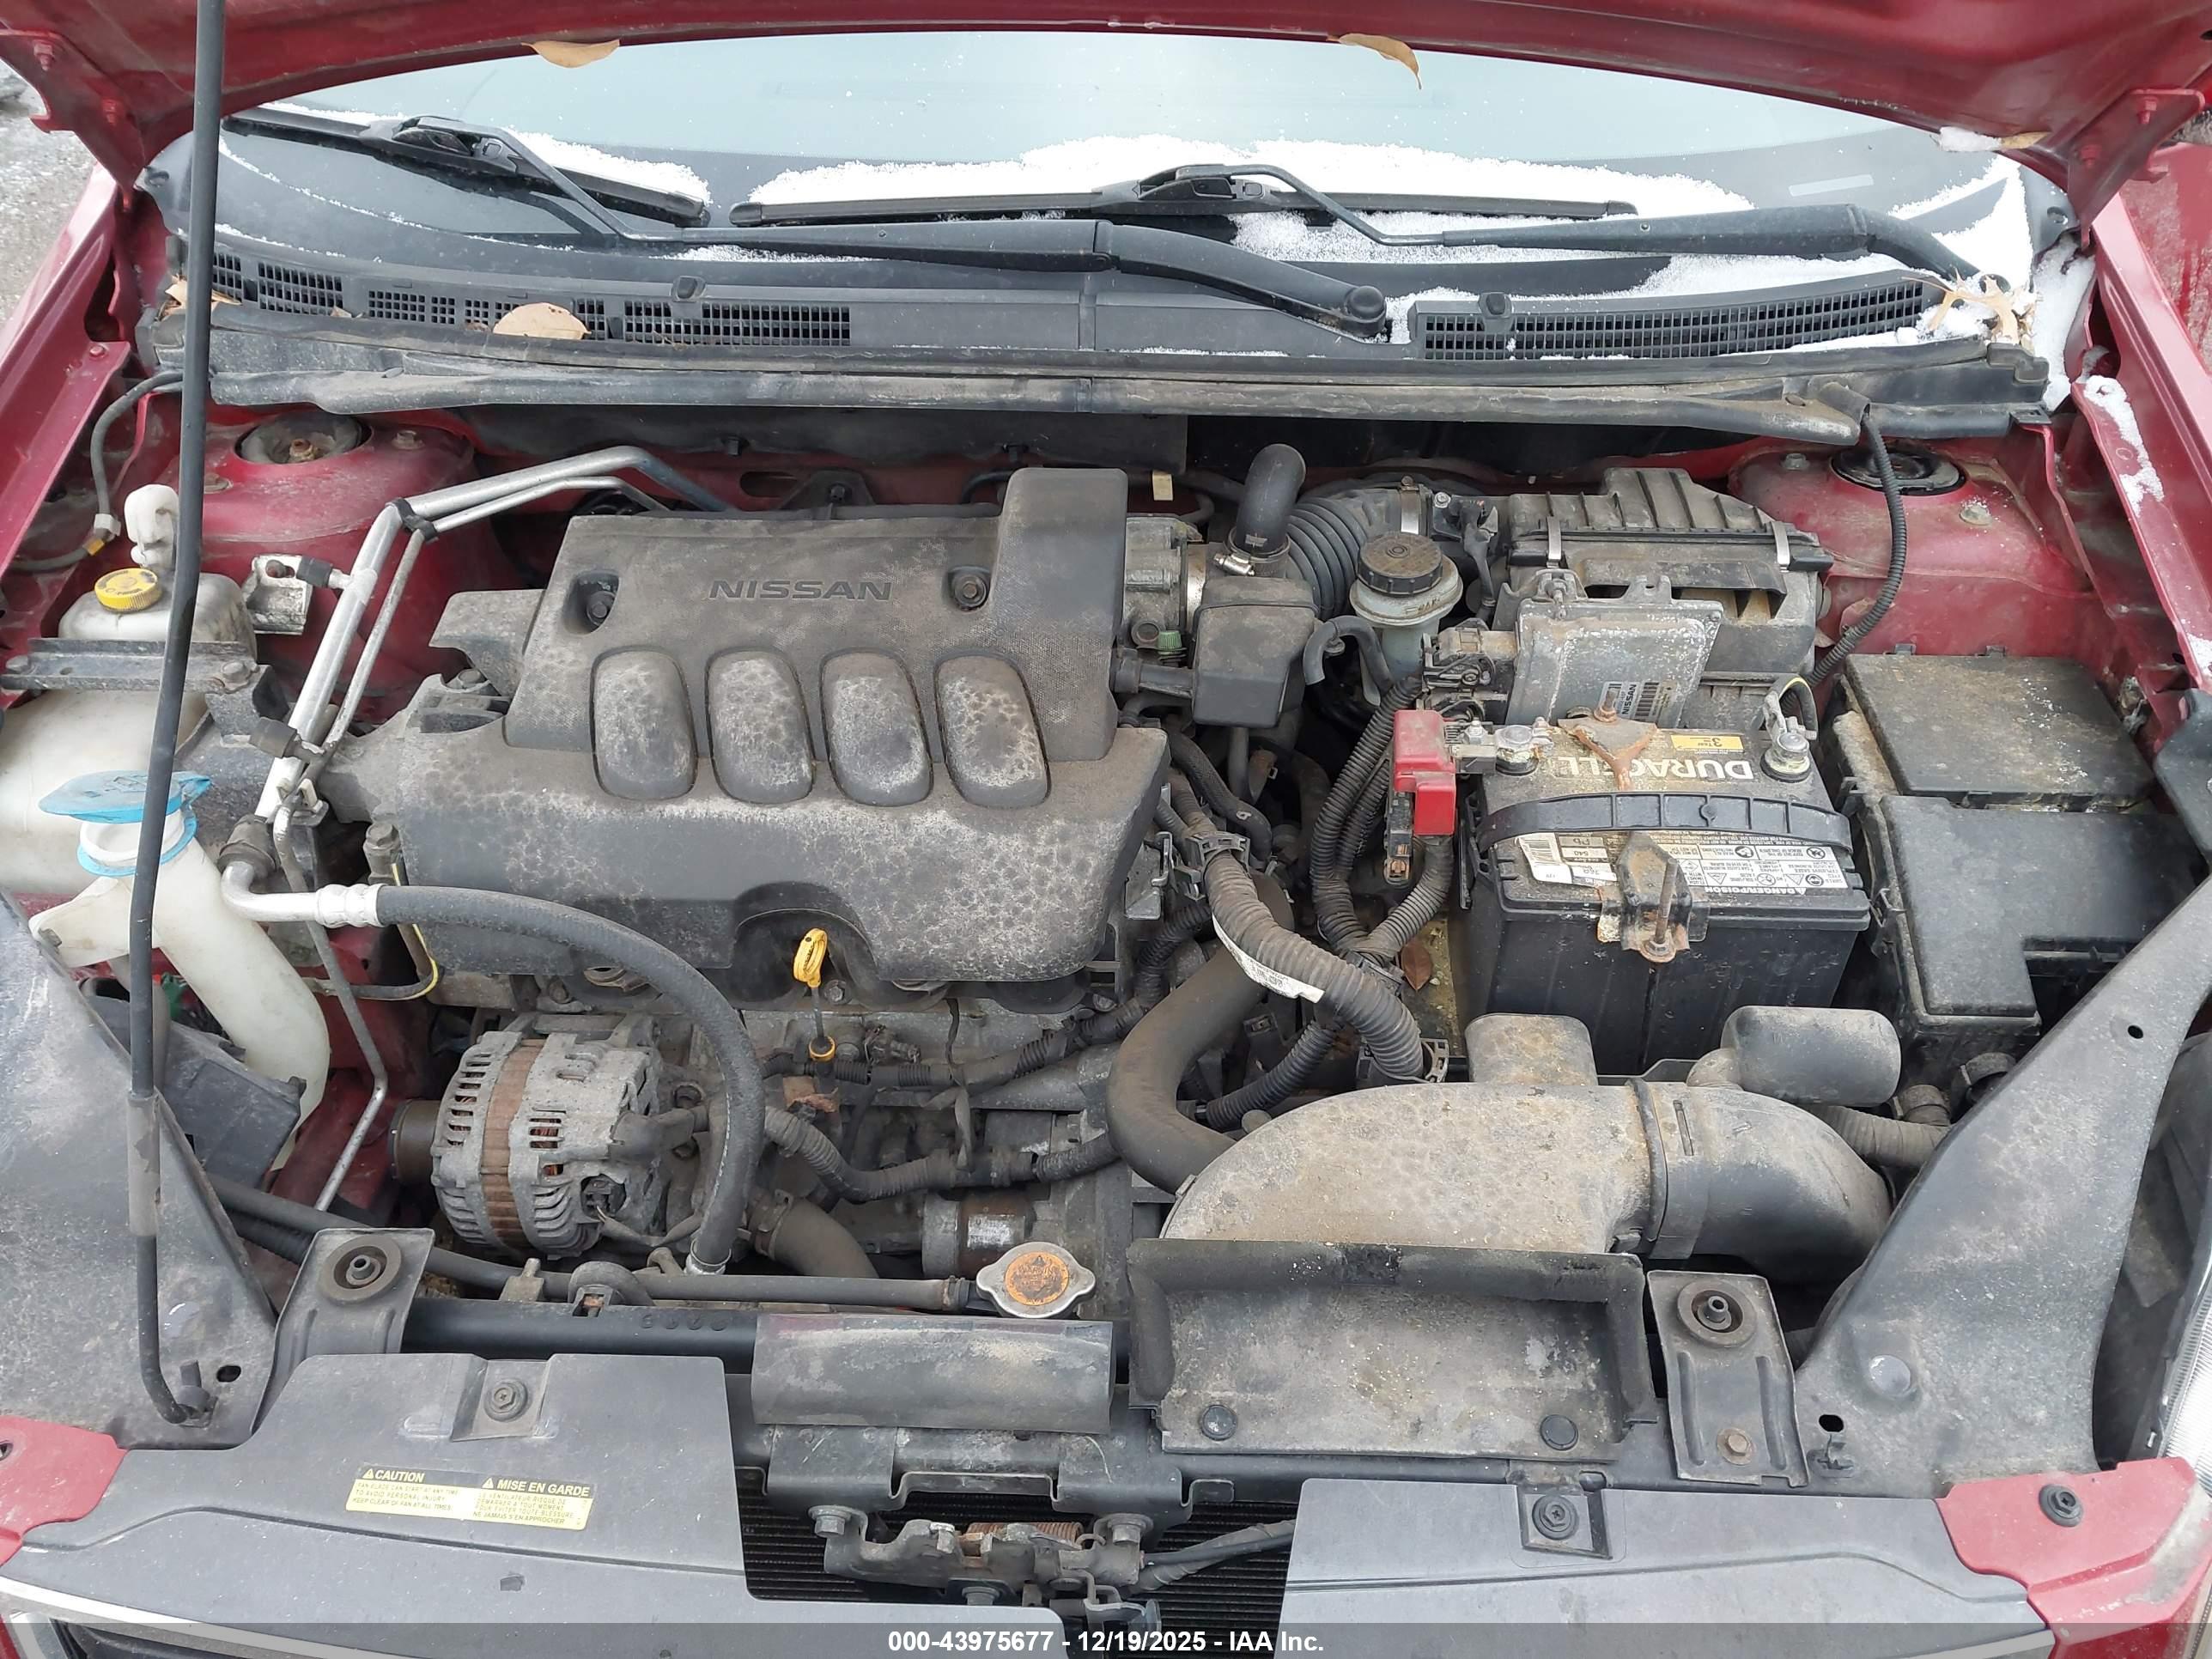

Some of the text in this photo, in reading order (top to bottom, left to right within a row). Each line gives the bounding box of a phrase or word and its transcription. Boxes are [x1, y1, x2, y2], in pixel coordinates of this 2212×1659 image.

[709, 580, 892, 601] NISSAN
[1621, 684, 1638, 714] NISSAN
[1712, 738, 1723, 747] 3
[1558, 757, 1754, 780] DURACLL
[1704, 886, 1796, 895] DANGER/POISON
[375, 1469, 425, 1482] CAUTION
[497, 1479, 590, 1497] MISE EN GARDE
